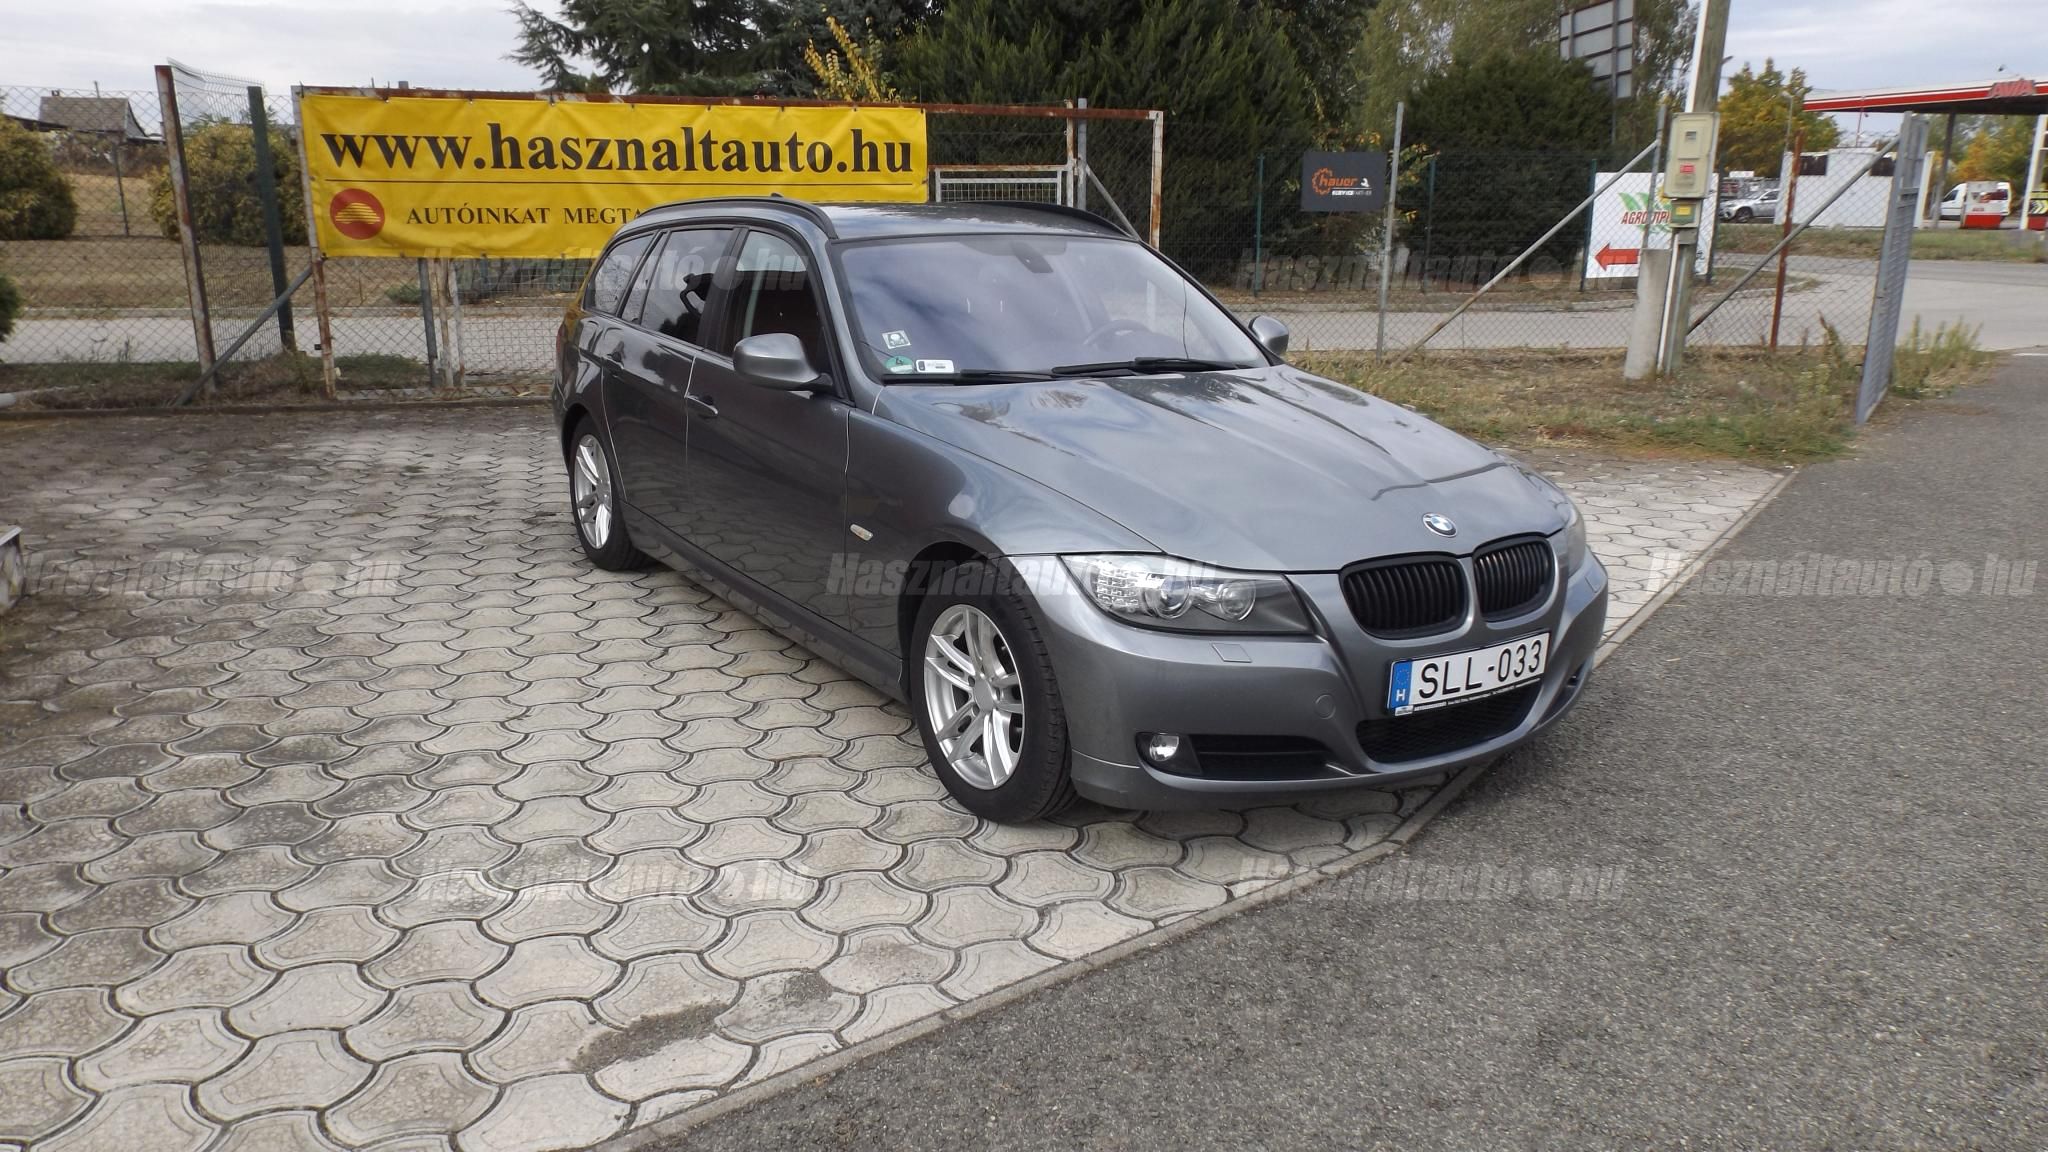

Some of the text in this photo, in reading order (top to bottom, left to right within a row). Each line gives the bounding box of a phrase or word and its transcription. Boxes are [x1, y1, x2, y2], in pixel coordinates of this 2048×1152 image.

[321, 122, 913, 173] www.hasznaltauto.hu
[406, 203, 551, 225] AUTÓINKAT
[1418, 639, 1542, 699] SLL-033
[1395, 689, 1406, 702] H
